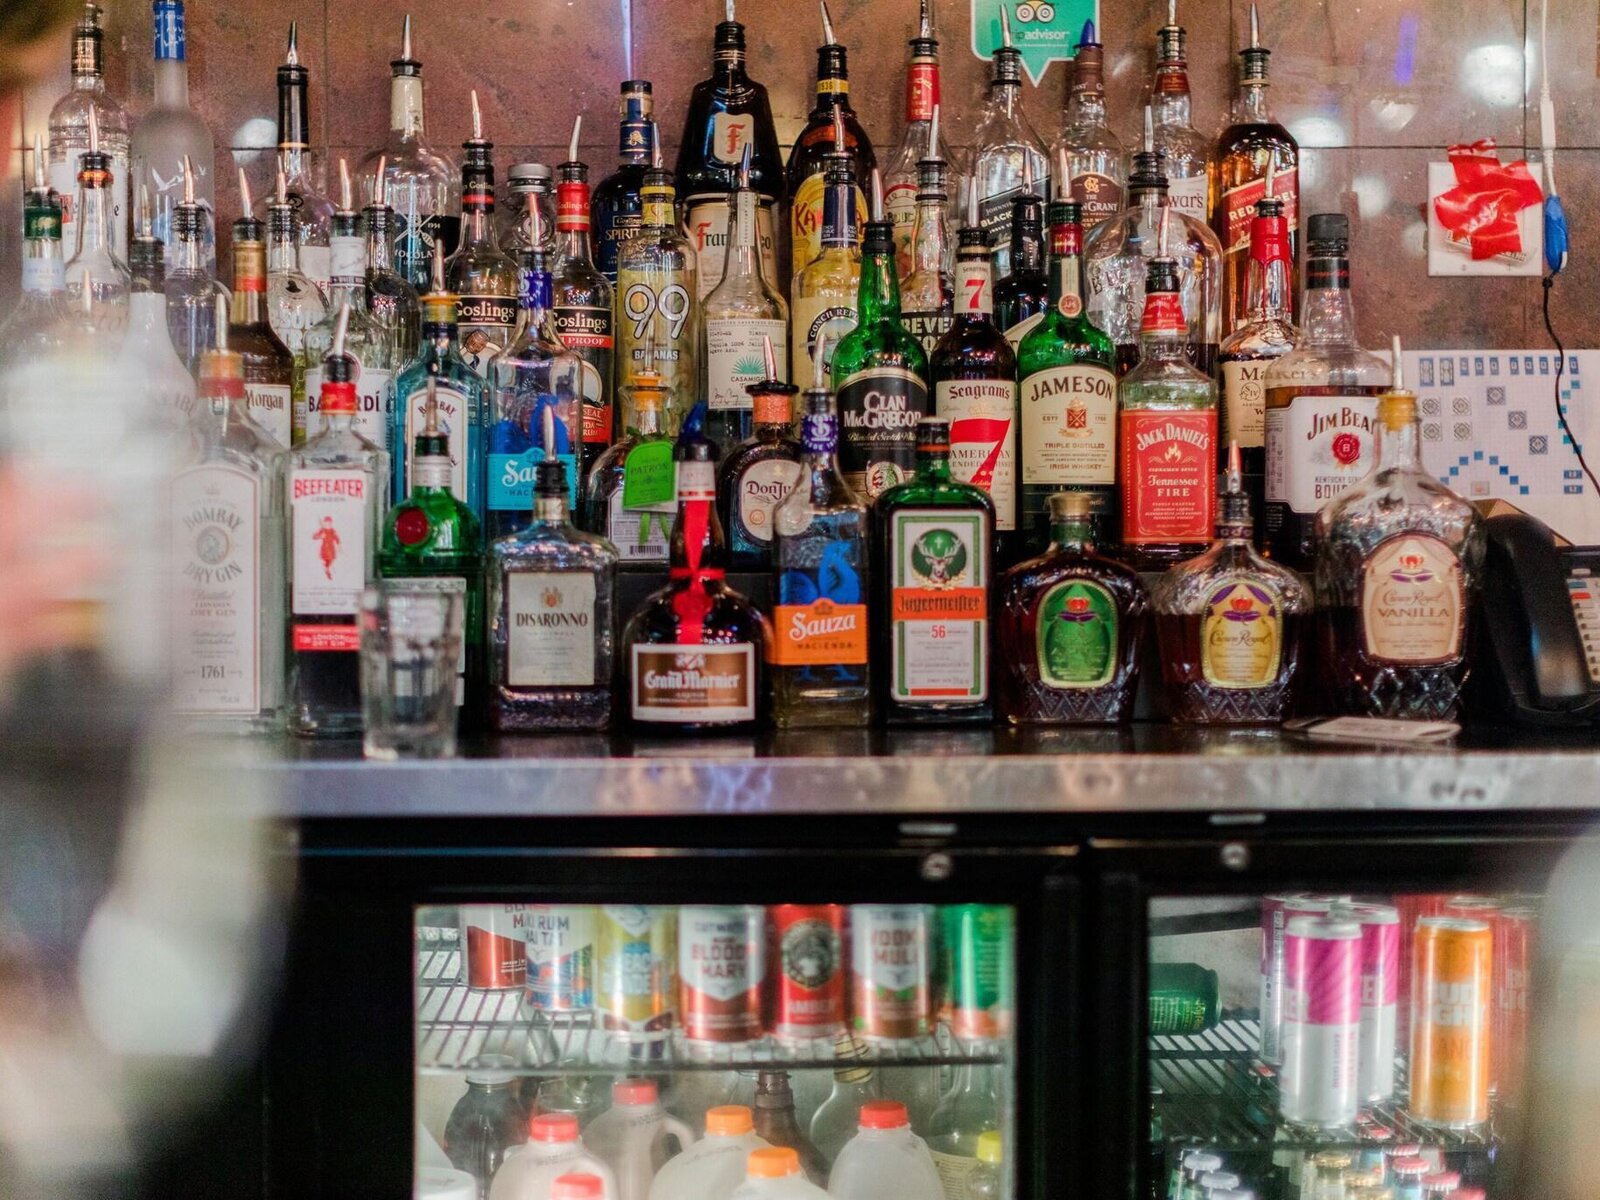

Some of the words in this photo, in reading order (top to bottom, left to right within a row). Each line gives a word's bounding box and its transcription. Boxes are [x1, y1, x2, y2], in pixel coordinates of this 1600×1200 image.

[726, 123, 746, 154] F
[1168, 193, 1204, 208] war's
[1228, 204, 1256, 222] RED
[965, 279, 986, 309] 7
[624, 283, 690, 339] 99
[567, 337, 604, 346] PROOF
[634, 349, 680, 361] BAANAS
[948, 384, 1010, 400] Seagram's
[1030, 376, 1114, 402] JAMESON
[245, 389, 284, 410] Morgan
[863, 391, 907, 411] CLAN
[1136, 426, 1166, 450] JACK
[1165, 422, 1210, 450] DANIEL'S
[1307, 412, 1337, 441] JIM
[294, 478, 364, 499] BEEFEATER
[1148, 474, 1199, 486] Tennessee
[1157, 488, 1191, 497] FIRE
[182, 506, 244, 531] BOMBAY
[183, 561, 214, 584] DRY
[215, 560, 243, 583] GIN
[516, 612, 588, 628] DISARONNO
[1378, 607, 1450, 618] VANILLA
[789, 612, 857, 641] Sauza
[931, 625, 946, 639] 56
[797, 641, 853, 650] HACIENDA
[200, 665, 226, 679] 1761
